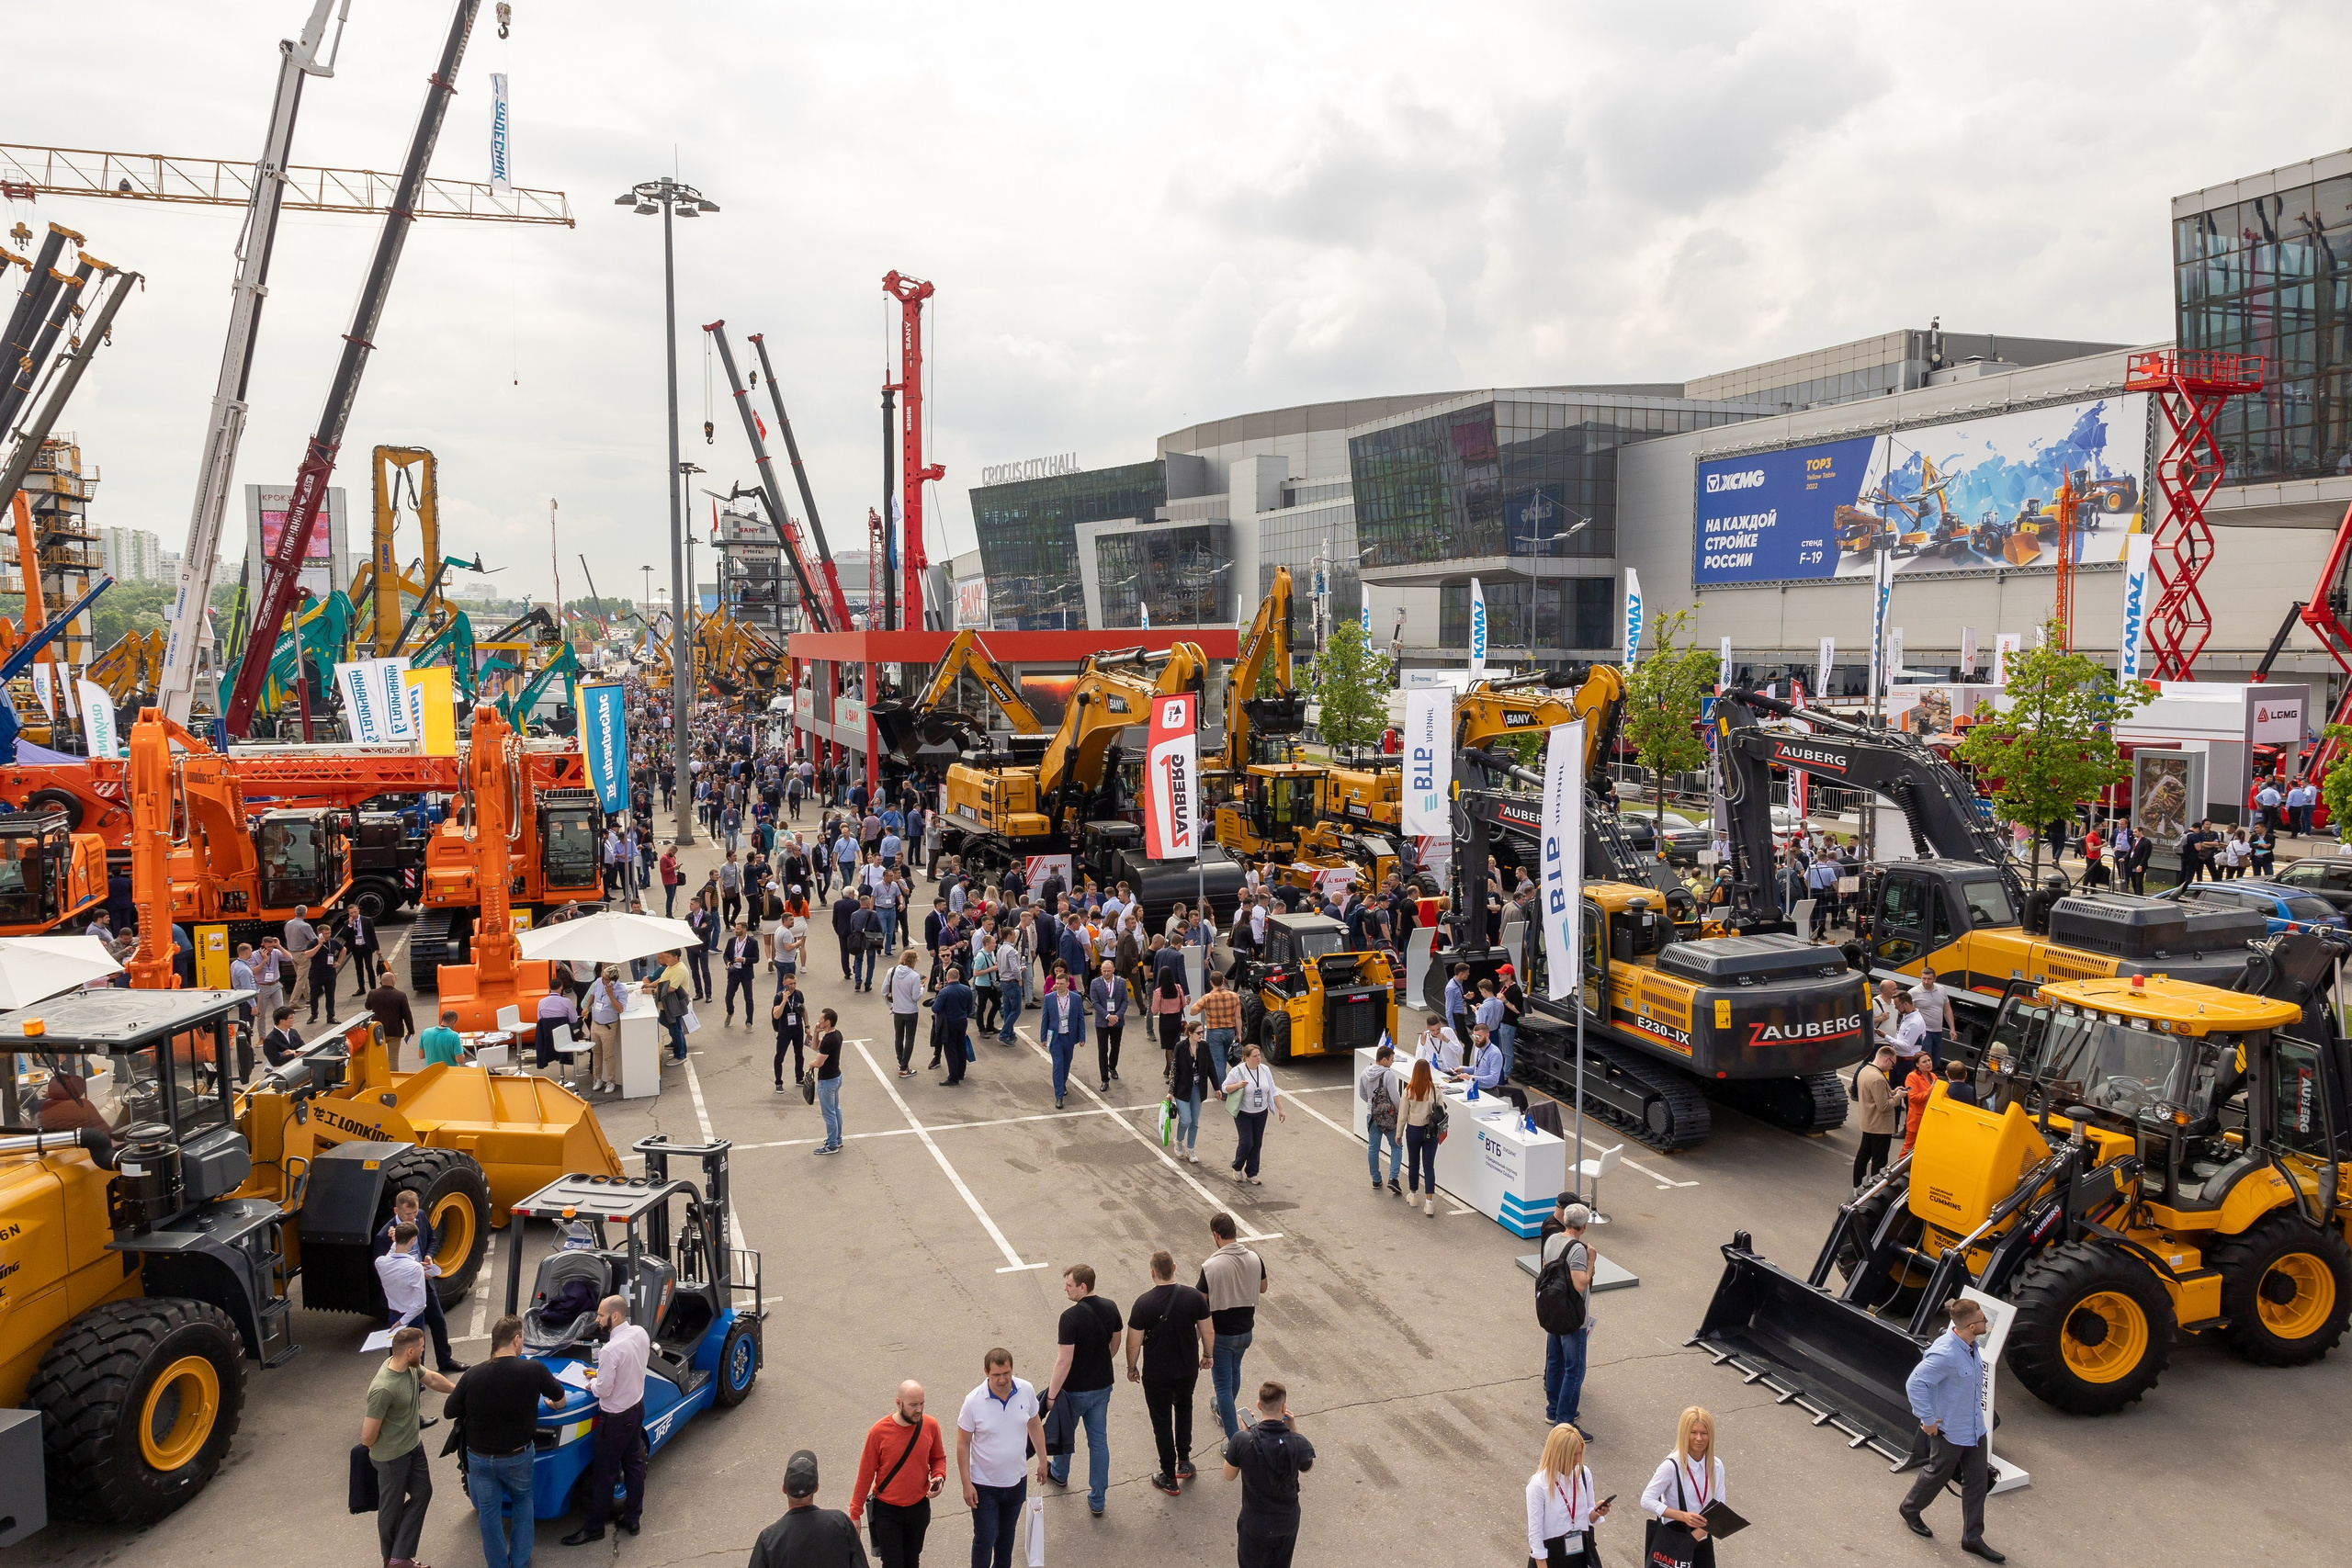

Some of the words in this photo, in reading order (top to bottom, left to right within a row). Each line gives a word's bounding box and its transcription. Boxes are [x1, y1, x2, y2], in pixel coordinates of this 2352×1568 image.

[981, 461, 1023, 486] CROCUS
[1023, 457, 1047, 479] CITY
[1048, 452, 1080, 477] HALL
[1806, 457, 1832, 472] TOP3
[1719, 469, 1765, 491] XCMG
[1806, 473, 1821, 481] Yellow
[1822, 471, 1836, 479] Table
[1805, 482, 1818, 491] 2022
[262, 493, 292, 504] КРОКУ
[1705, 519, 1721, 533] НА
[1723, 509, 1777, 530] КАЖДОЙ
[1705, 532, 1758, 551] СТРОЙКЕ
[1801, 539, 1823, 548] стенд
[1704, 553, 1753, 570] РОССИИ
[1800, 551, 1823, 565] F-19
[961, 582, 983, 614] SANY
[1474, 600, 1486, 659] KAMAZ
[1627, 593, 1641, 663] KAMAZ
[2124, 571, 2145, 675] KAMAZ
[1247, 636, 1258, 656] SANY
[414, 643, 444, 670] SUNWARD
[534, 671, 554, 694] SUNWARD
[990, 682, 1009, 703] SANY
[1108, 698, 1128, 711] SANY
[2270, 710, 2298, 719] LGMG
[848, 711, 859, 724] SANY
[1507, 714, 1531, 725] SANY
[1774, 741, 1847, 769] ZAUBERG
[1498, 804, 1544, 826] ZAUBER
[1341, 839, 1355, 850] SANY
[1348, 994, 1370, 1003] ZAUBERG
[1636, 1016, 1690, 1045] E230-IX
[1748, 1014, 1861, 1046] ZAUBERG
[1486, 1137, 1502, 1157] ВТБ
[1929, 1195, 1962, 1212] CUMMINS
[2029, 1204, 2062, 1245] ZAUBERG
[652, 1412, 673, 1445] TRF
